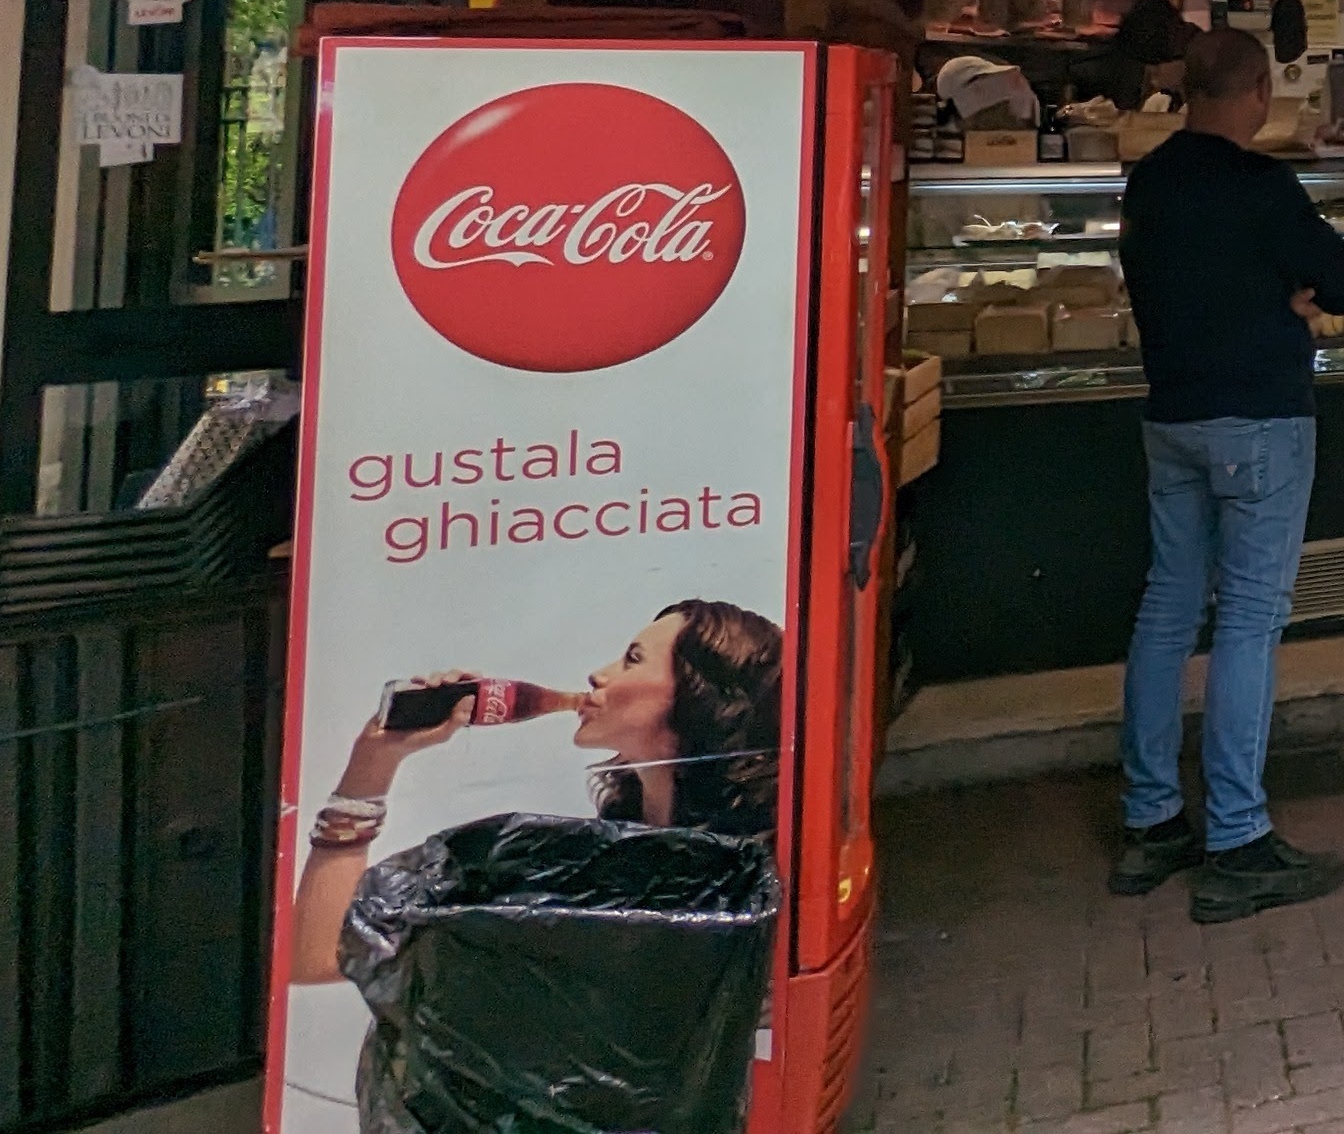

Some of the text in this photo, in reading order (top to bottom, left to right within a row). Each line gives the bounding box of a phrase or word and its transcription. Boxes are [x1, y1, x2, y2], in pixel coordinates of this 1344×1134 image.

[413, 183, 731, 269] Coca-Cola
[348, 429, 623, 502] gustala
[384, 486, 761, 564] ghiacciata
